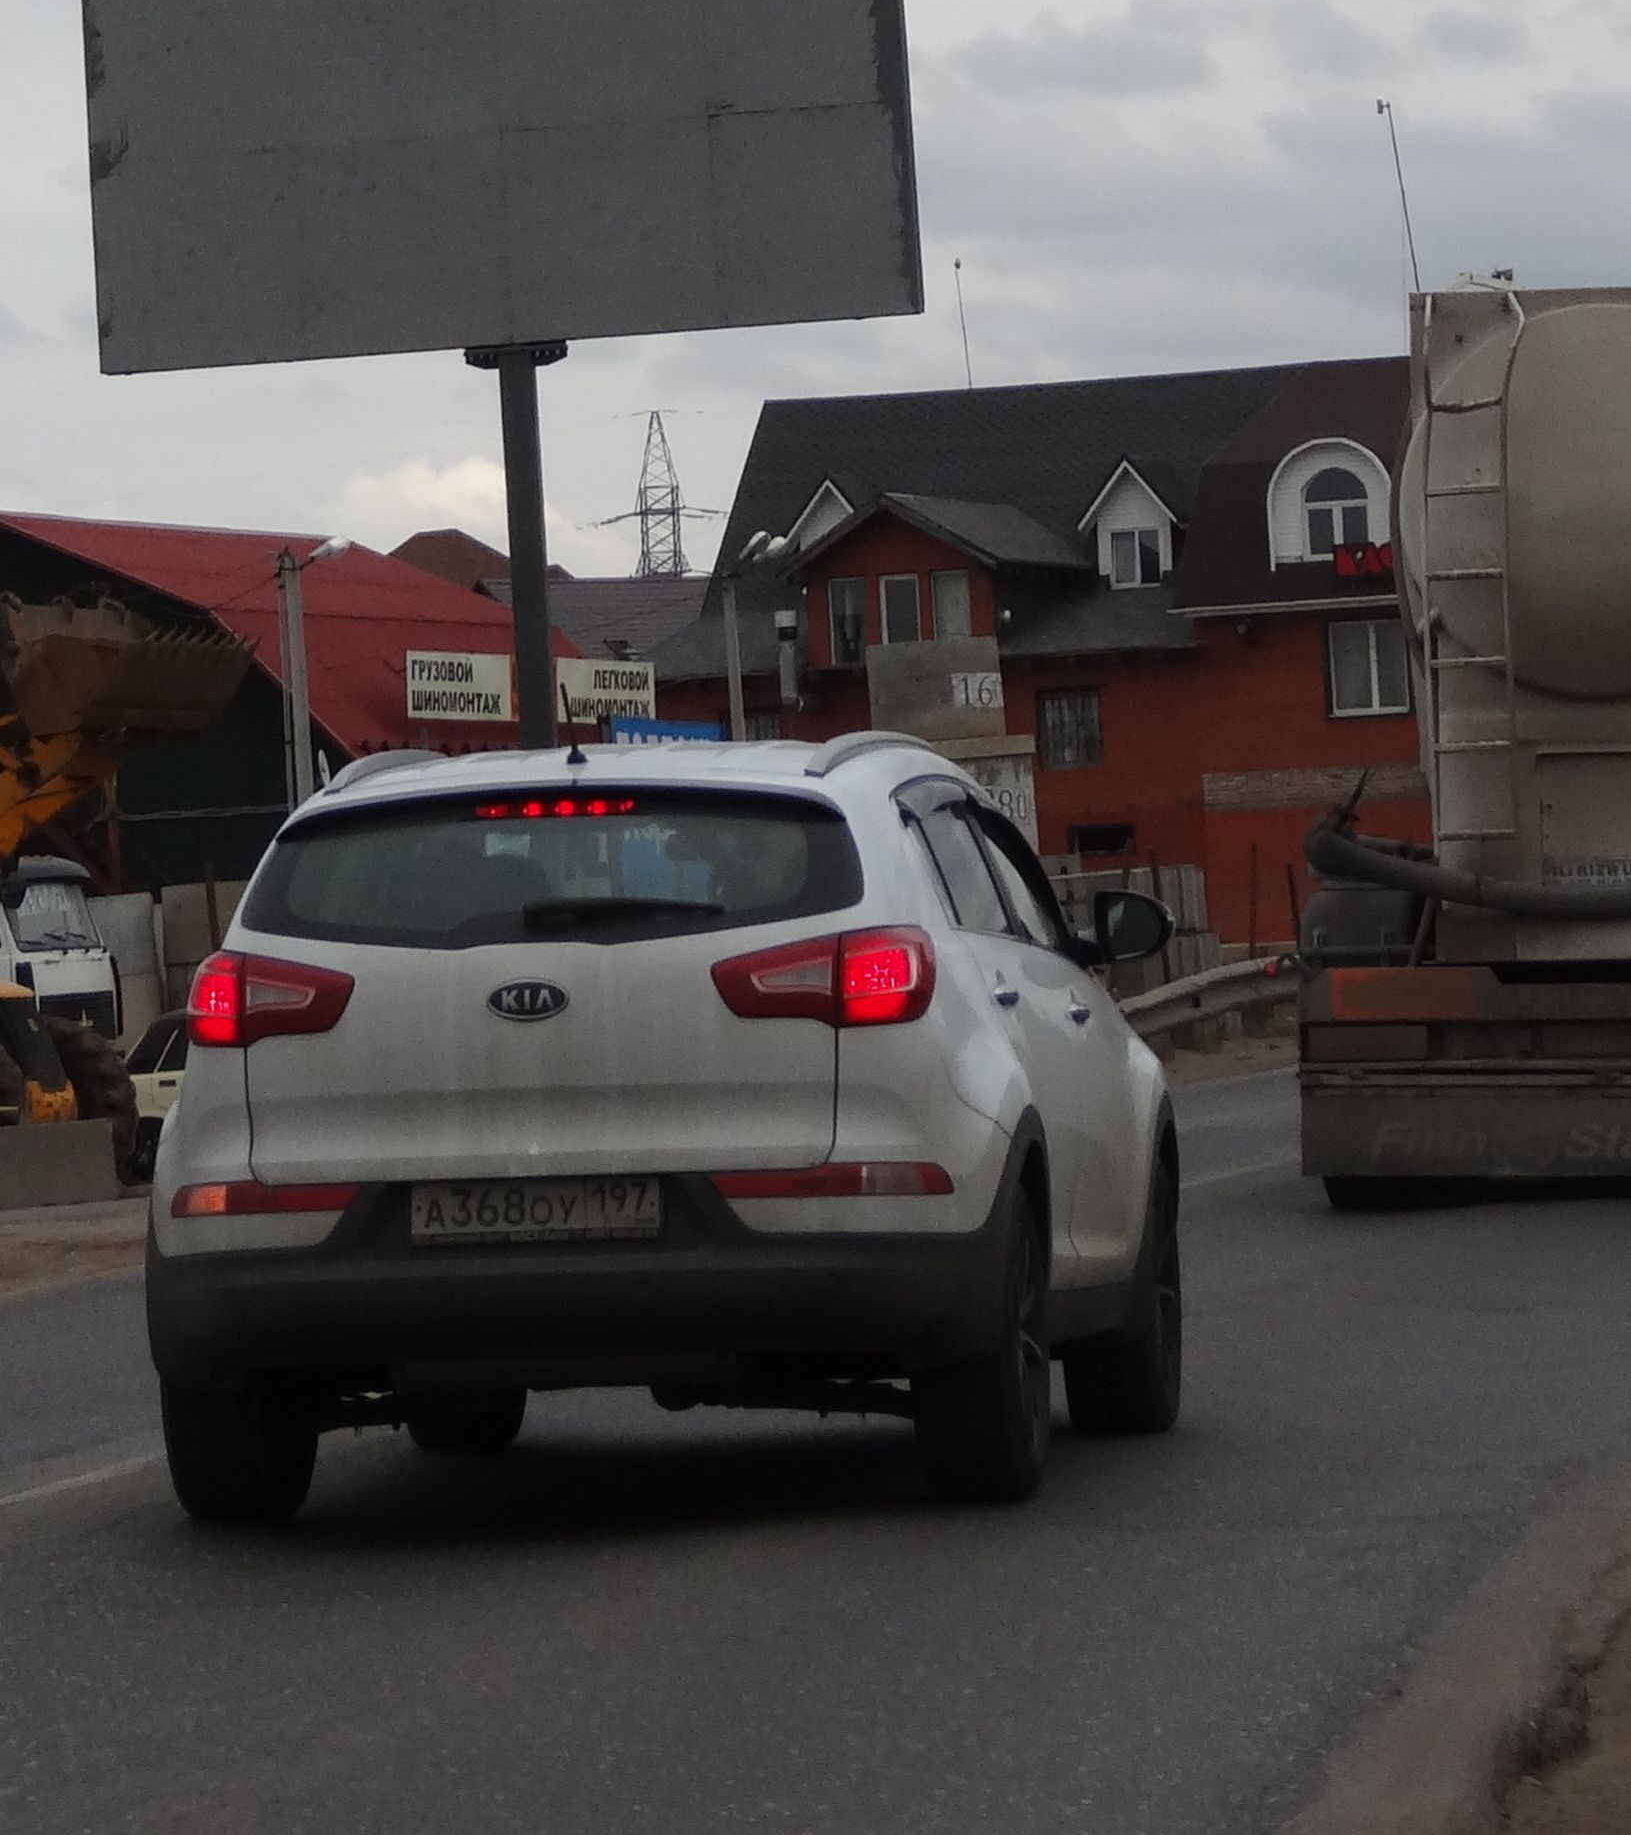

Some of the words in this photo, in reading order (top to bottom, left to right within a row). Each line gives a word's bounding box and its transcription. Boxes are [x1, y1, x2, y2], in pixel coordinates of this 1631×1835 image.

[410, 655, 473, 682] ГРУЗОВОЙ
[593, 666, 651, 691] ЛЕГКОВОЙ
[411, 689, 502, 715] ШИНОМОНТАЖ
[501, 989, 555, 1012] KIA
[590, 1181, 648, 1213] 197
